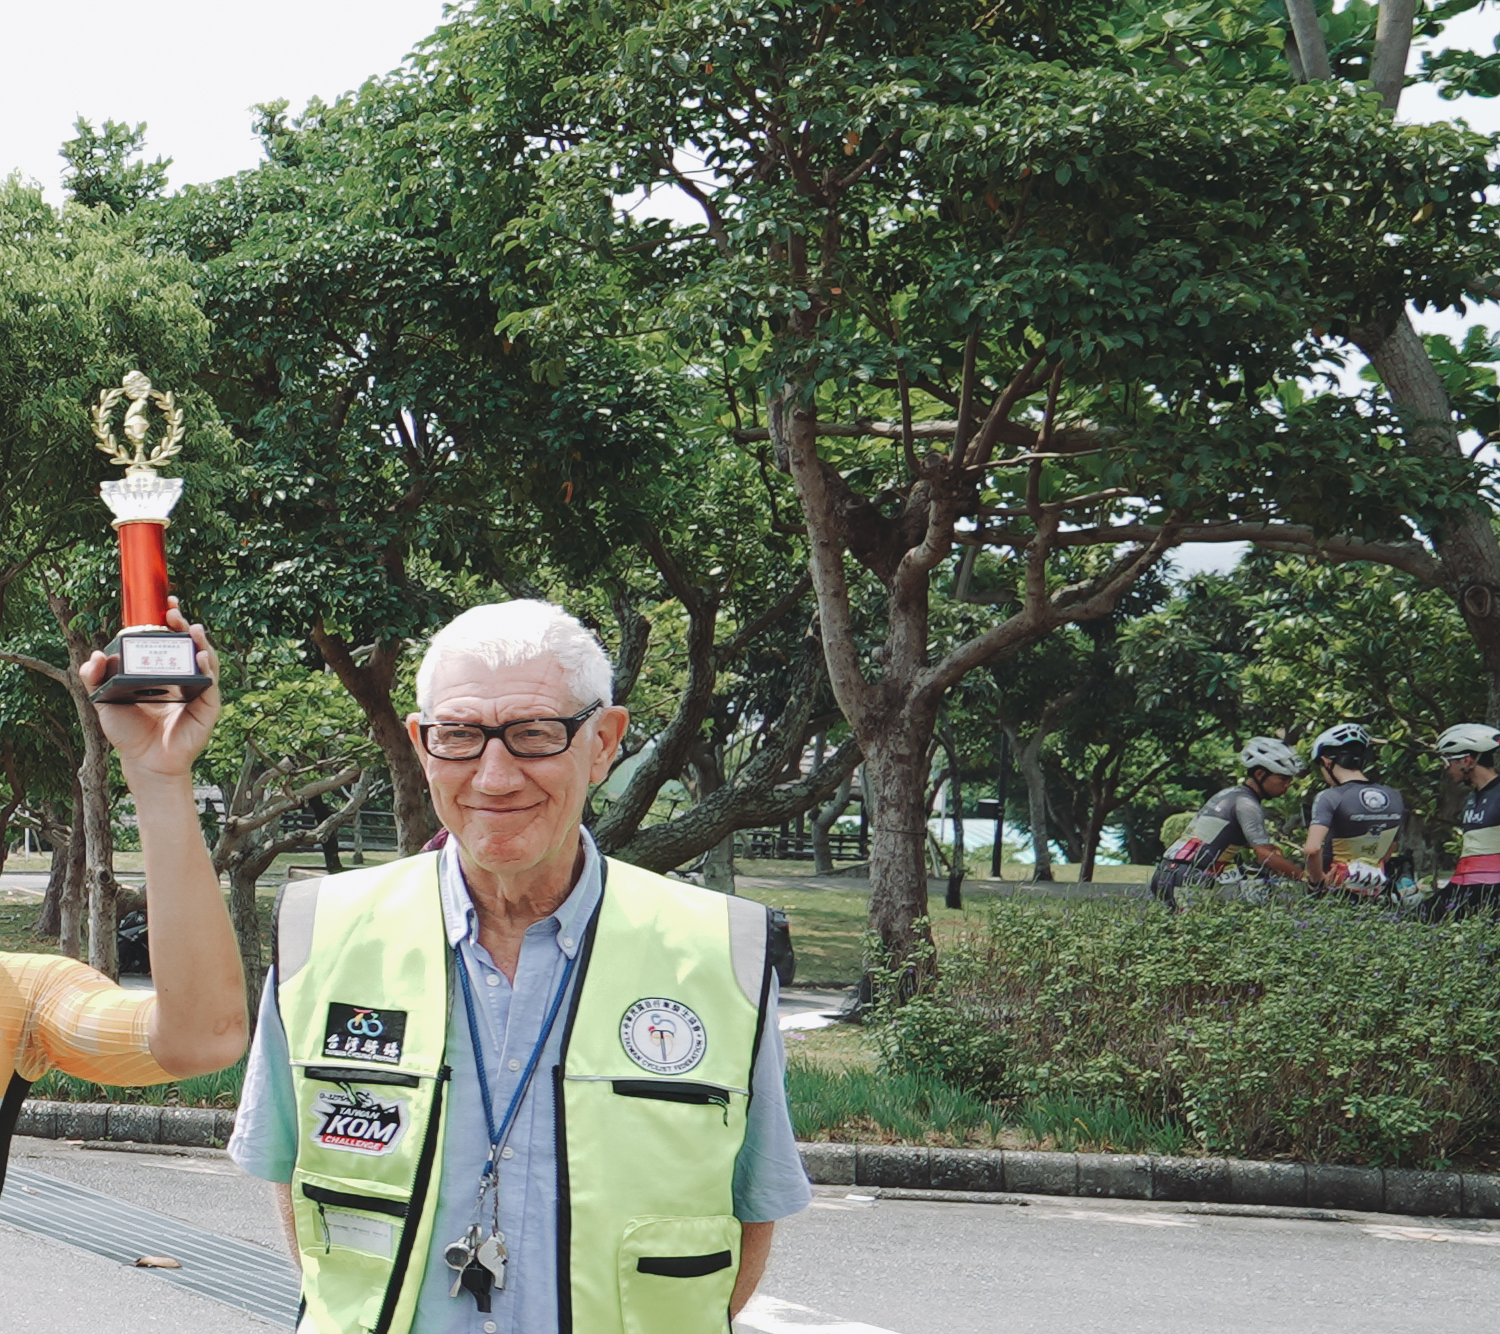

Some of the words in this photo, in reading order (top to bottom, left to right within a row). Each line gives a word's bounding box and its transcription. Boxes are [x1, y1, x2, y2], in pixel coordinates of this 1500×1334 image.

[339, 1107, 381, 1119] TAIWAN
[325, 1114, 398, 1143] KOM
[324, 1135, 383, 1151] CHALLENGE
